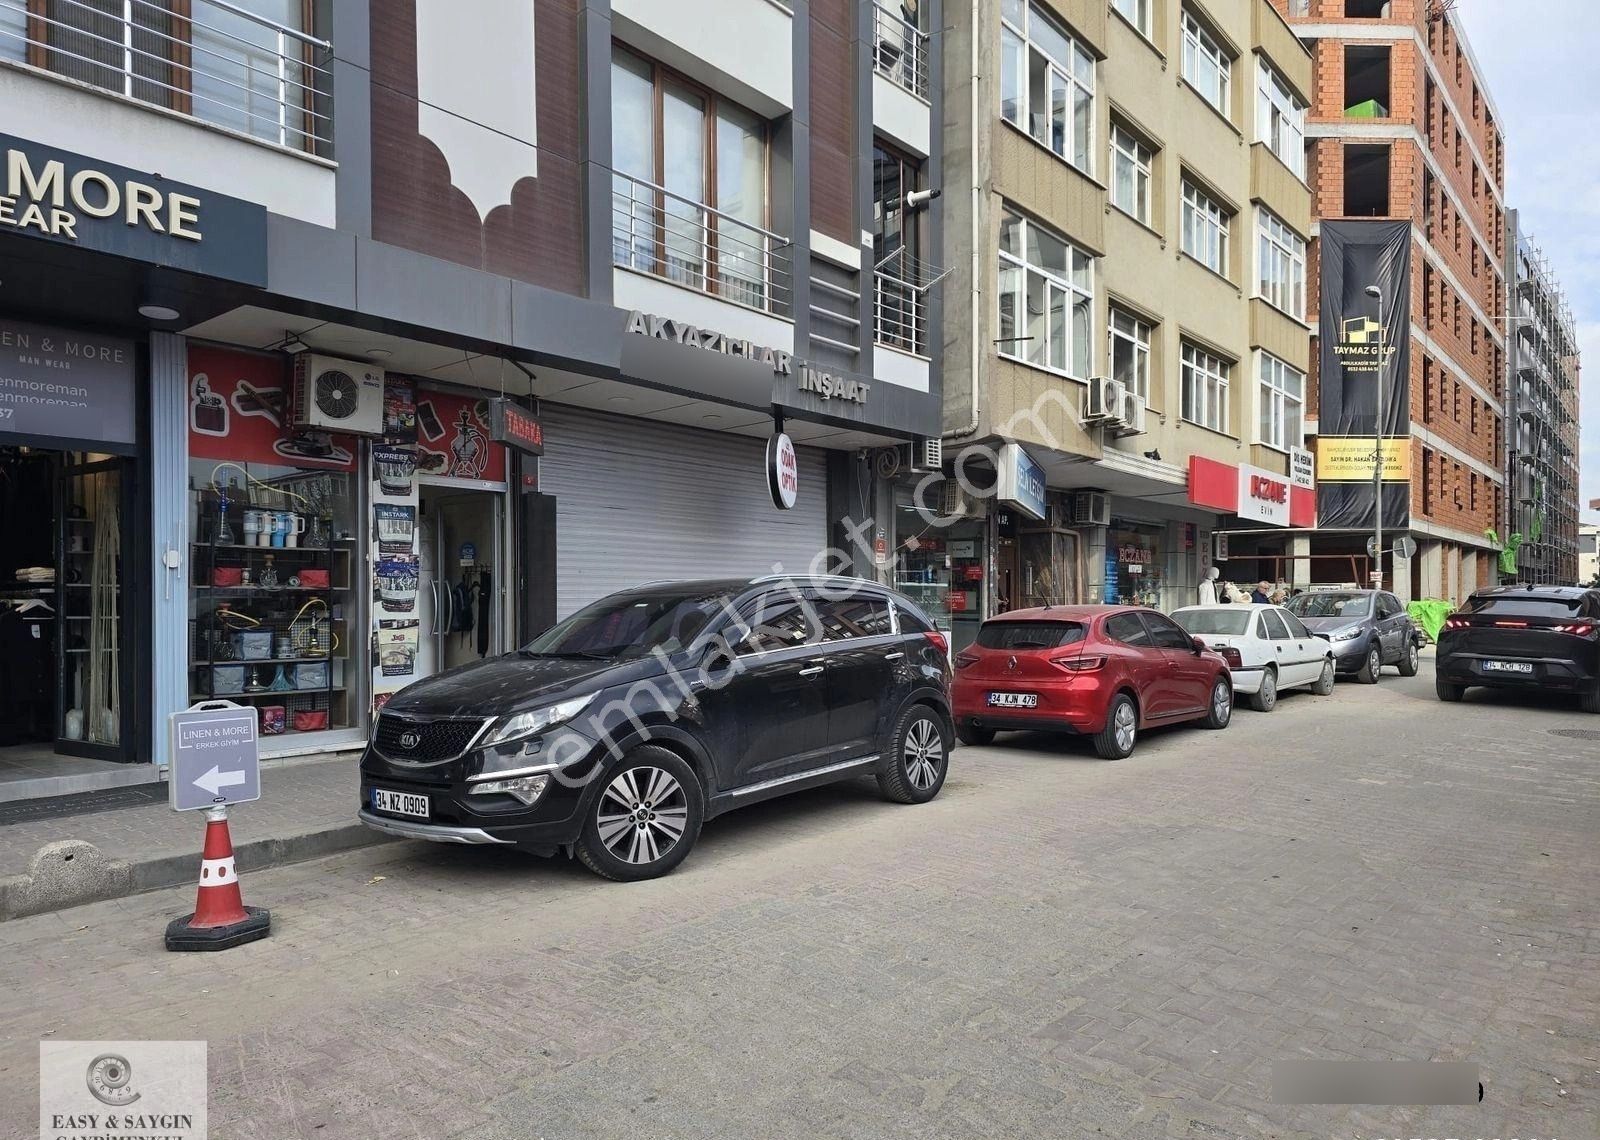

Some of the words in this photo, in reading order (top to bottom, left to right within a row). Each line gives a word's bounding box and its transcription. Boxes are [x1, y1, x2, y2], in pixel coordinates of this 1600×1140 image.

[7, 149, 202, 241] MORE
[41, 338, 54, 352] &
[65, 341, 123, 363] MORE
[1333, 346, 1370, 355] TAYMAZ
[1371, 347, 1396, 355] GUP
[19, 355, 40, 366] MAN
[45, 359, 71, 370] WEAR
[799, 361, 870, 404] İNŞAAT
[781, 448, 796, 471] ODAK
[781, 471, 797, 492] OPTİK
[992, 693, 1001, 703] 34
[1004, 694, 1019, 704] KJN
[1022, 695, 1036, 705] 478
[183, 729, 211, 739] LINEN
[213, 728, 221, 737] &
[222, 725, 249, 736] MORE
[401, 735, 414, 746] KIA
[220, 738, 240, 746] GİYİM
[376, 791, 387, 809] 34
[389, 794, 400, 811] NZ
[403, 796, 426, 815] 0909
